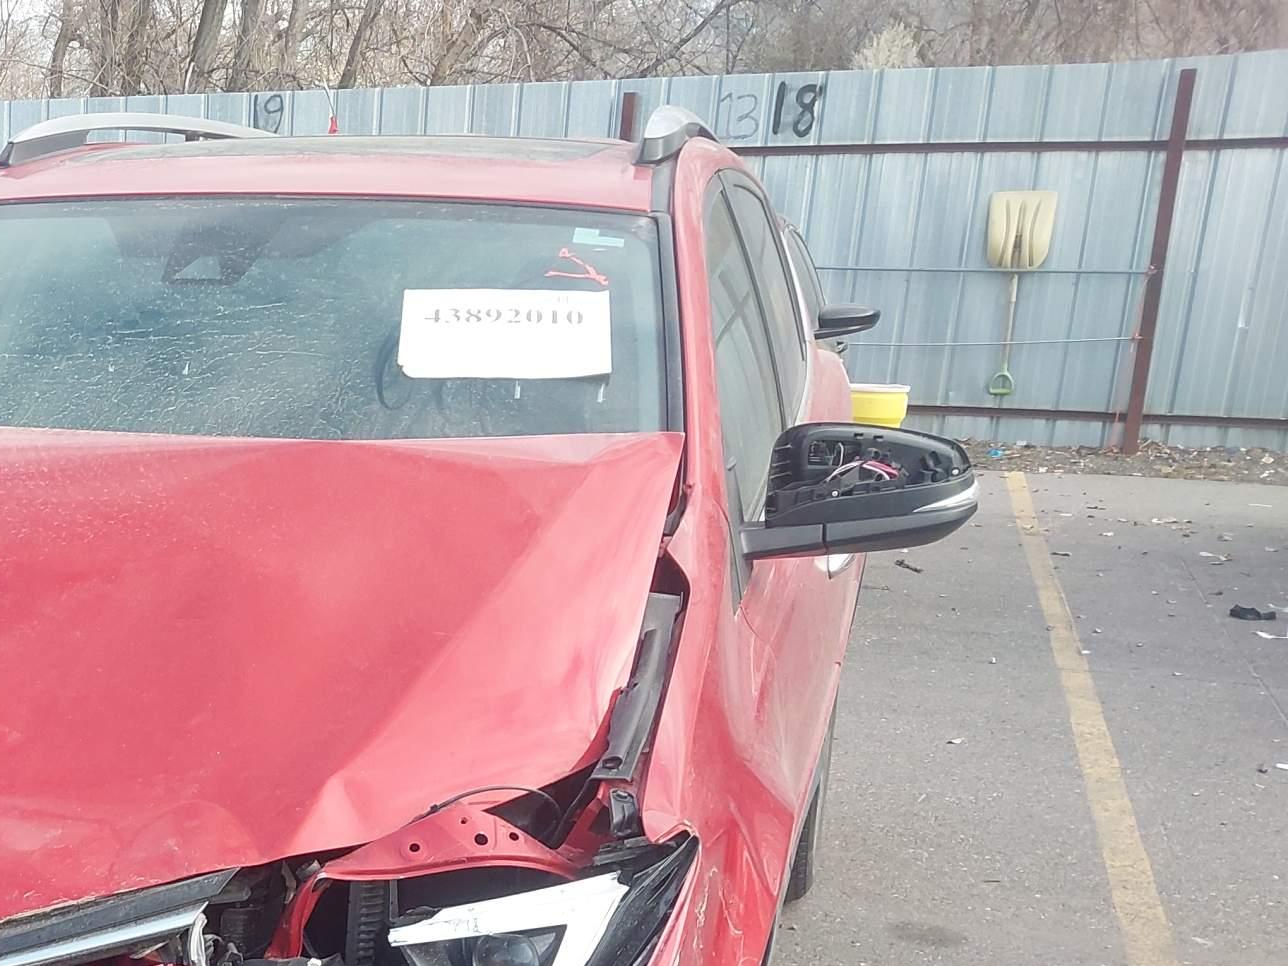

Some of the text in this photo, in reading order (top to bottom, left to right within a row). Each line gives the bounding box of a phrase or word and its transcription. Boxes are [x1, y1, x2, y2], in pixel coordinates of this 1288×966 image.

[253, 94, 284, 134] 19
[772, 81, 823, 138] 18
[424, 308, 584, 324] 43892010
